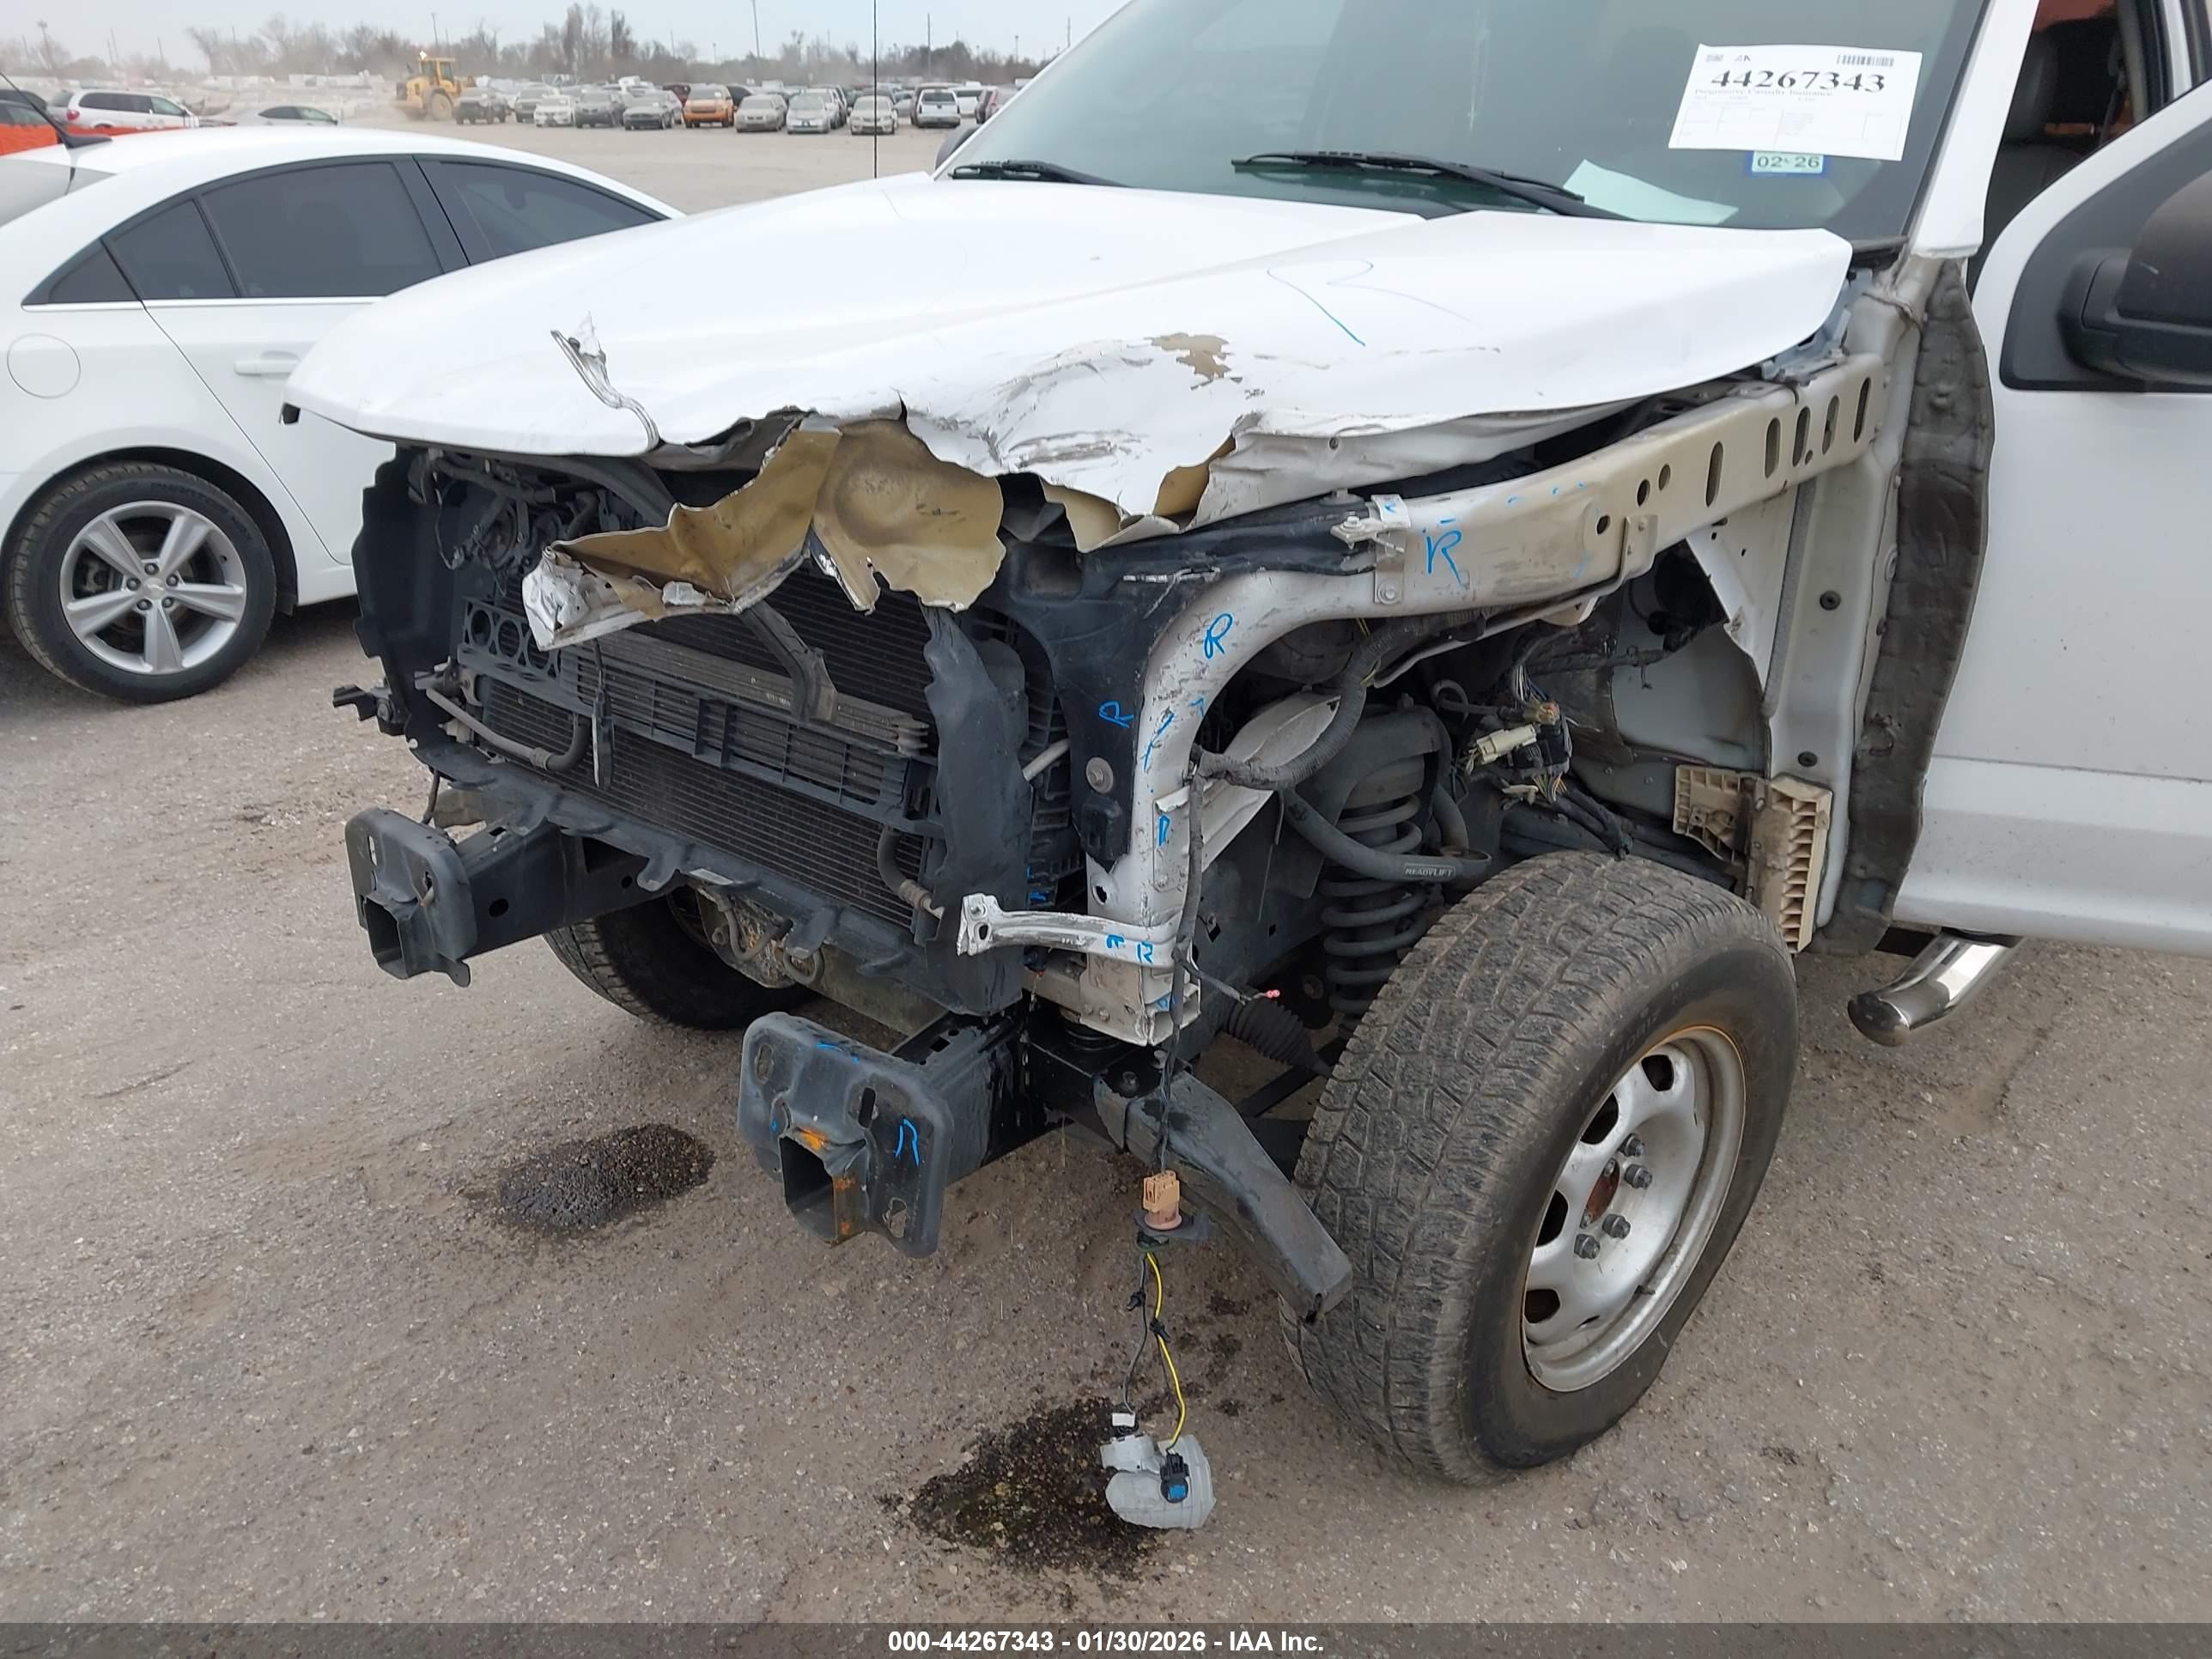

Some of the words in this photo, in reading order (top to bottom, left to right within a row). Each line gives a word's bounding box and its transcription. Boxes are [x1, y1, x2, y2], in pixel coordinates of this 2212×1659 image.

[1711, 70, 1885, 93] 44267343
[1757, 155, 1783, 168] 02
[1794, 155, 1820, 168] 26
[1405, 867, 1454, 877] READYLIFT
